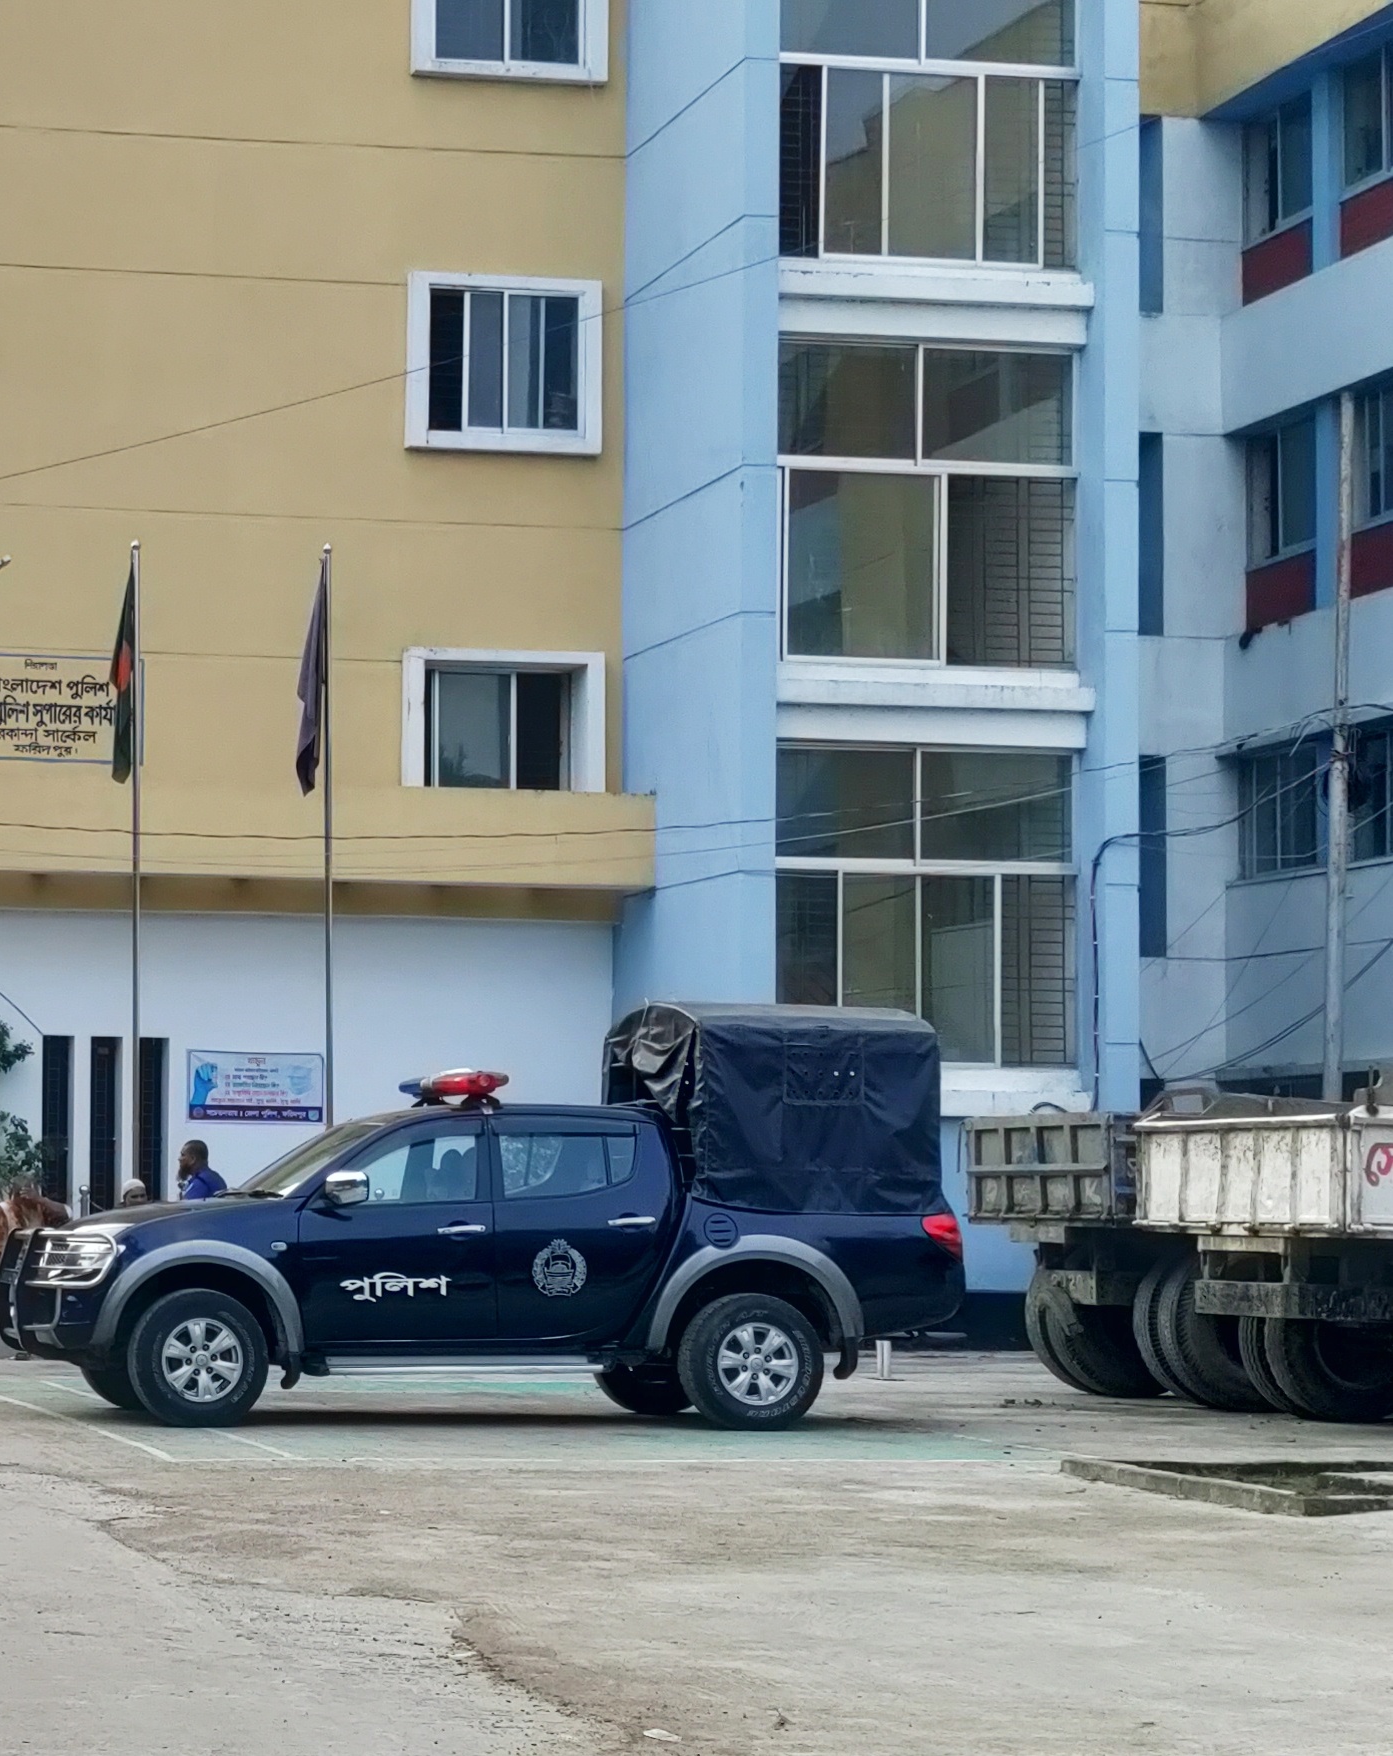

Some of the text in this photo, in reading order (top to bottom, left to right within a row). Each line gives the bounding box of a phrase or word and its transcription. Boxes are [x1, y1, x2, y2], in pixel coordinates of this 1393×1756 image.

[66, 674, 110, 699] পুলিশ
[32, 702, 83, 728] সুপারের
[43, 725, 97, 744] সার্কেল
[340, 1272, 452, 1302] পুলিশ
